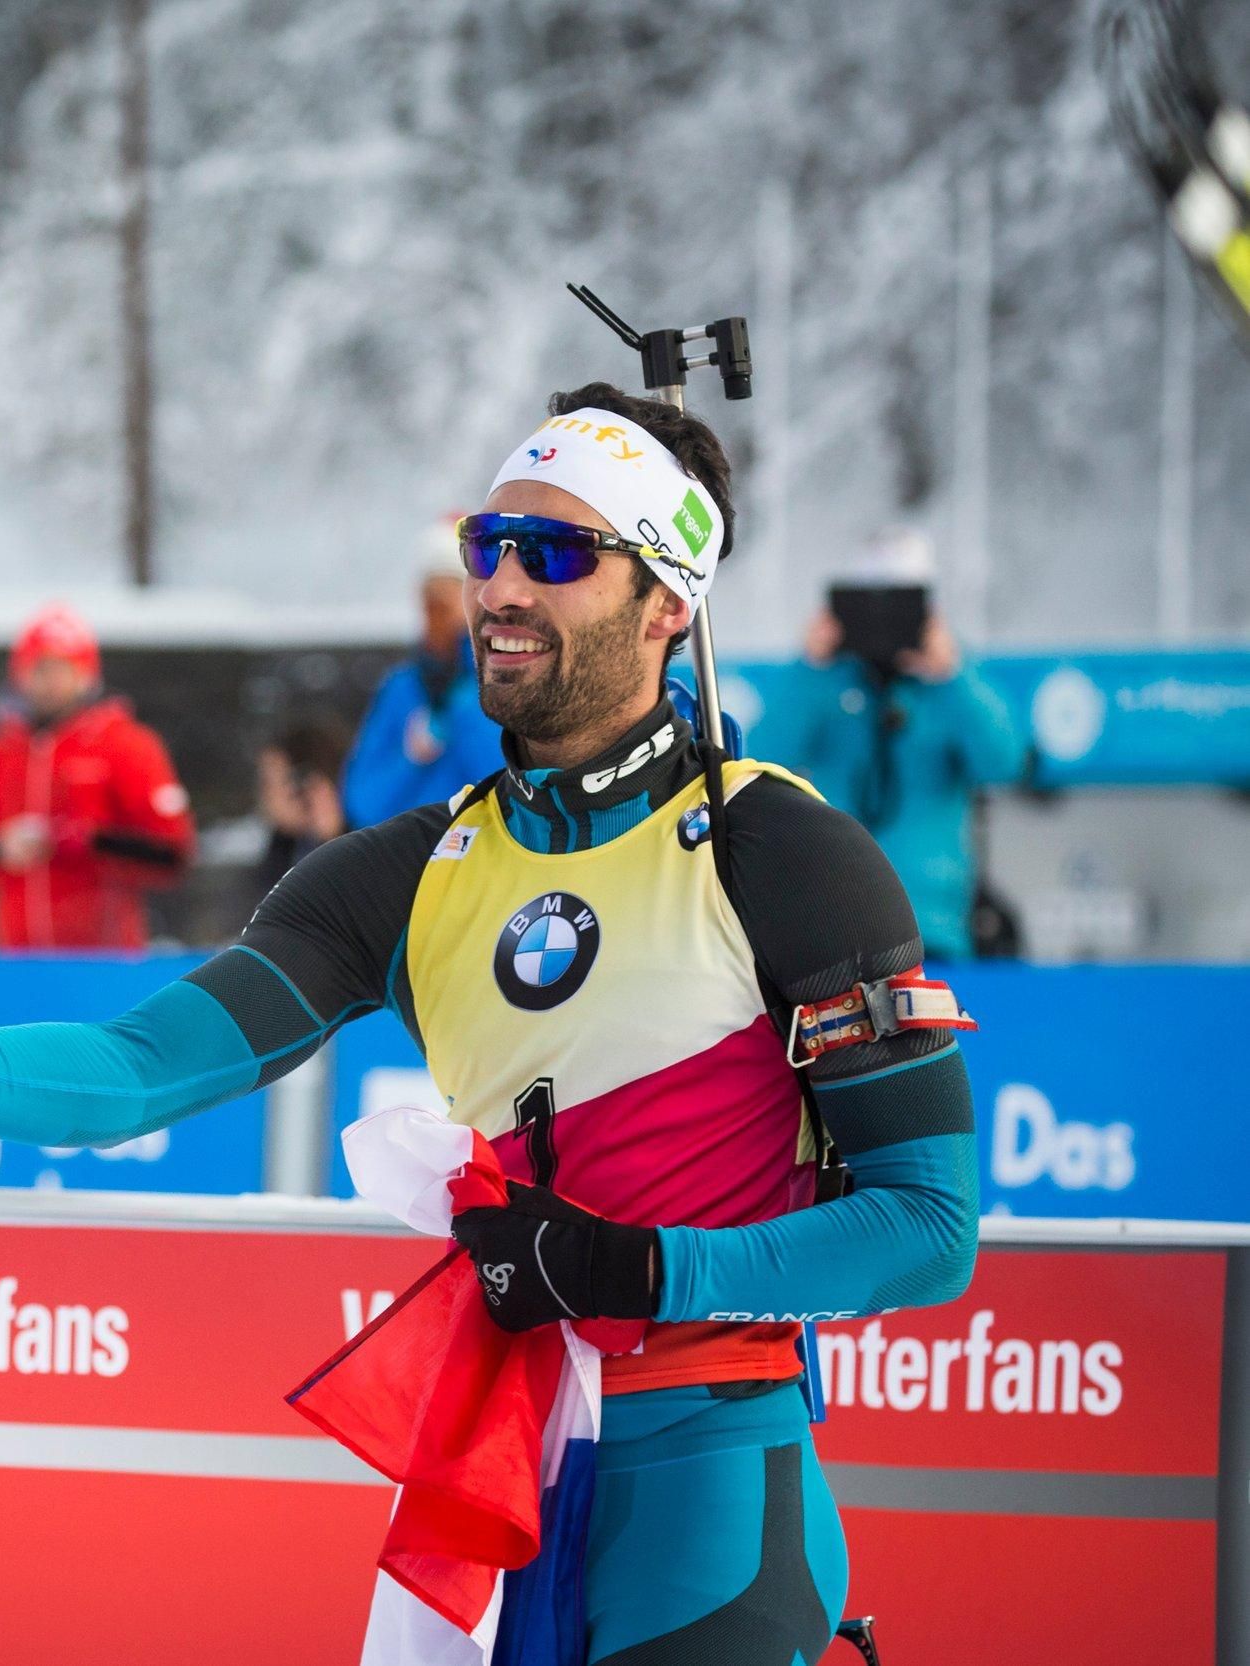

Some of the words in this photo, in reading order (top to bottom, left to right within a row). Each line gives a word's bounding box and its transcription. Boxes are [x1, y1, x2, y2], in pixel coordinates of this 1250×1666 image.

[535, 416, 644, 460] mfy
[508, 895, 596, 937] BMW
[992, 1083, 1136, 1190] Das
[818, 1310, 1124, 1417] nterfans
